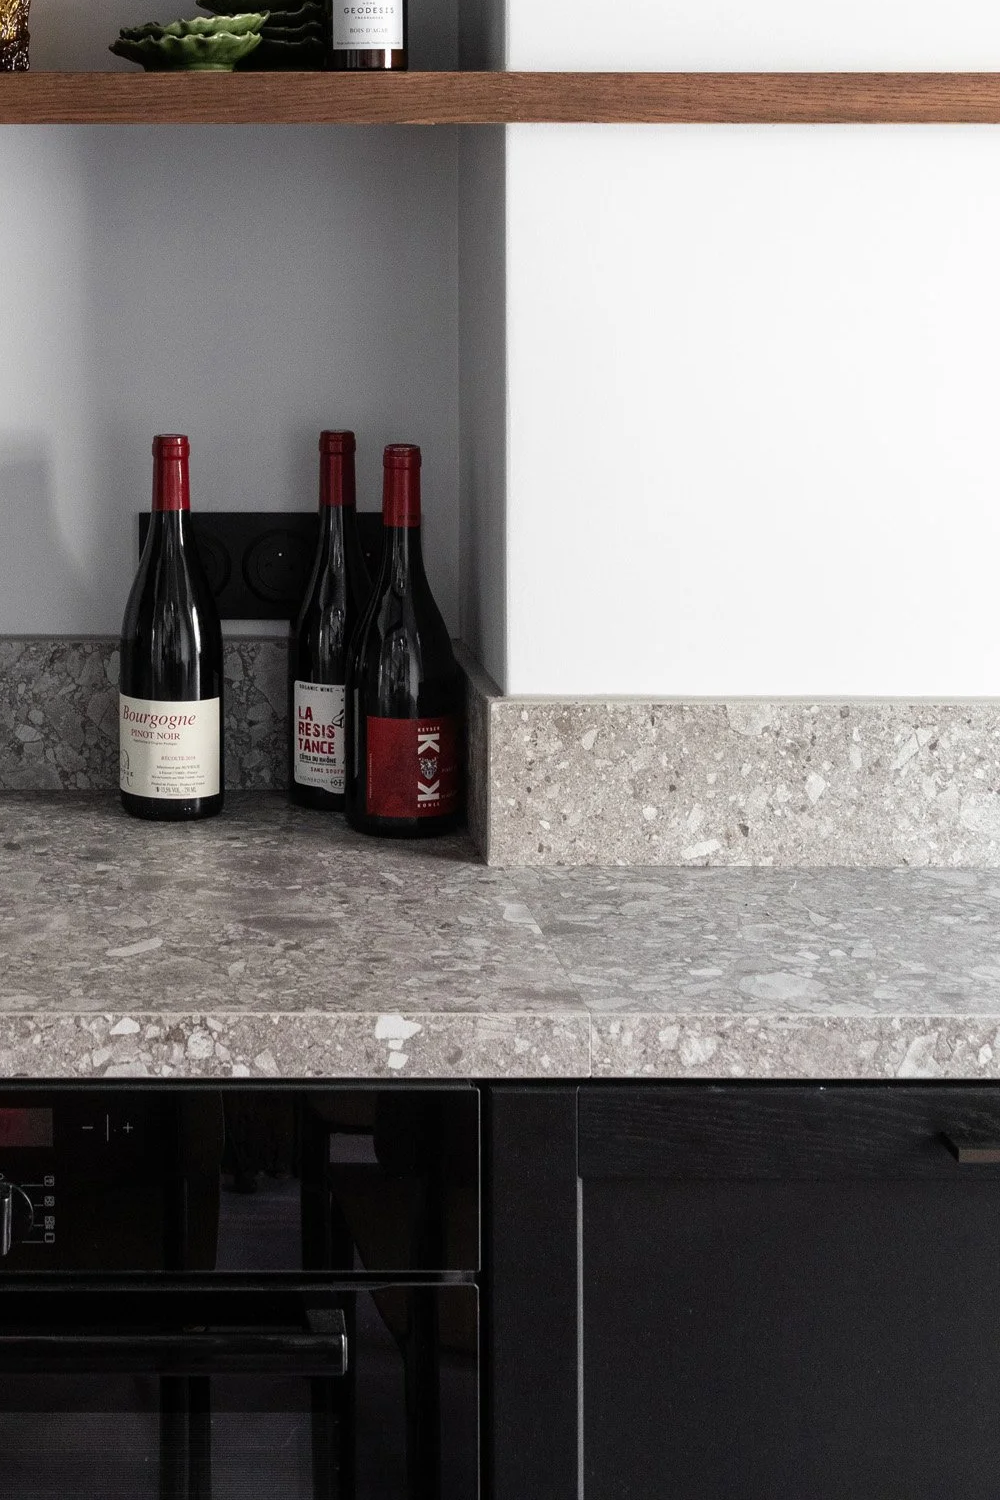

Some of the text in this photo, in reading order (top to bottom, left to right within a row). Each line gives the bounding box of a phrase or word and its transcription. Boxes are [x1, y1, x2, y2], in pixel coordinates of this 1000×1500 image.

[123, 705, 197, 730] Bourgogne
[298, 706, 313, 721] LA
[131, 729, 181, 740] PINOT NOIR
[298, 721, 336, 739] RESIS
[298, 738, 336, 755] TANCE
[417, 733, 440, 755] K
[417, 780, 440, 802] K
